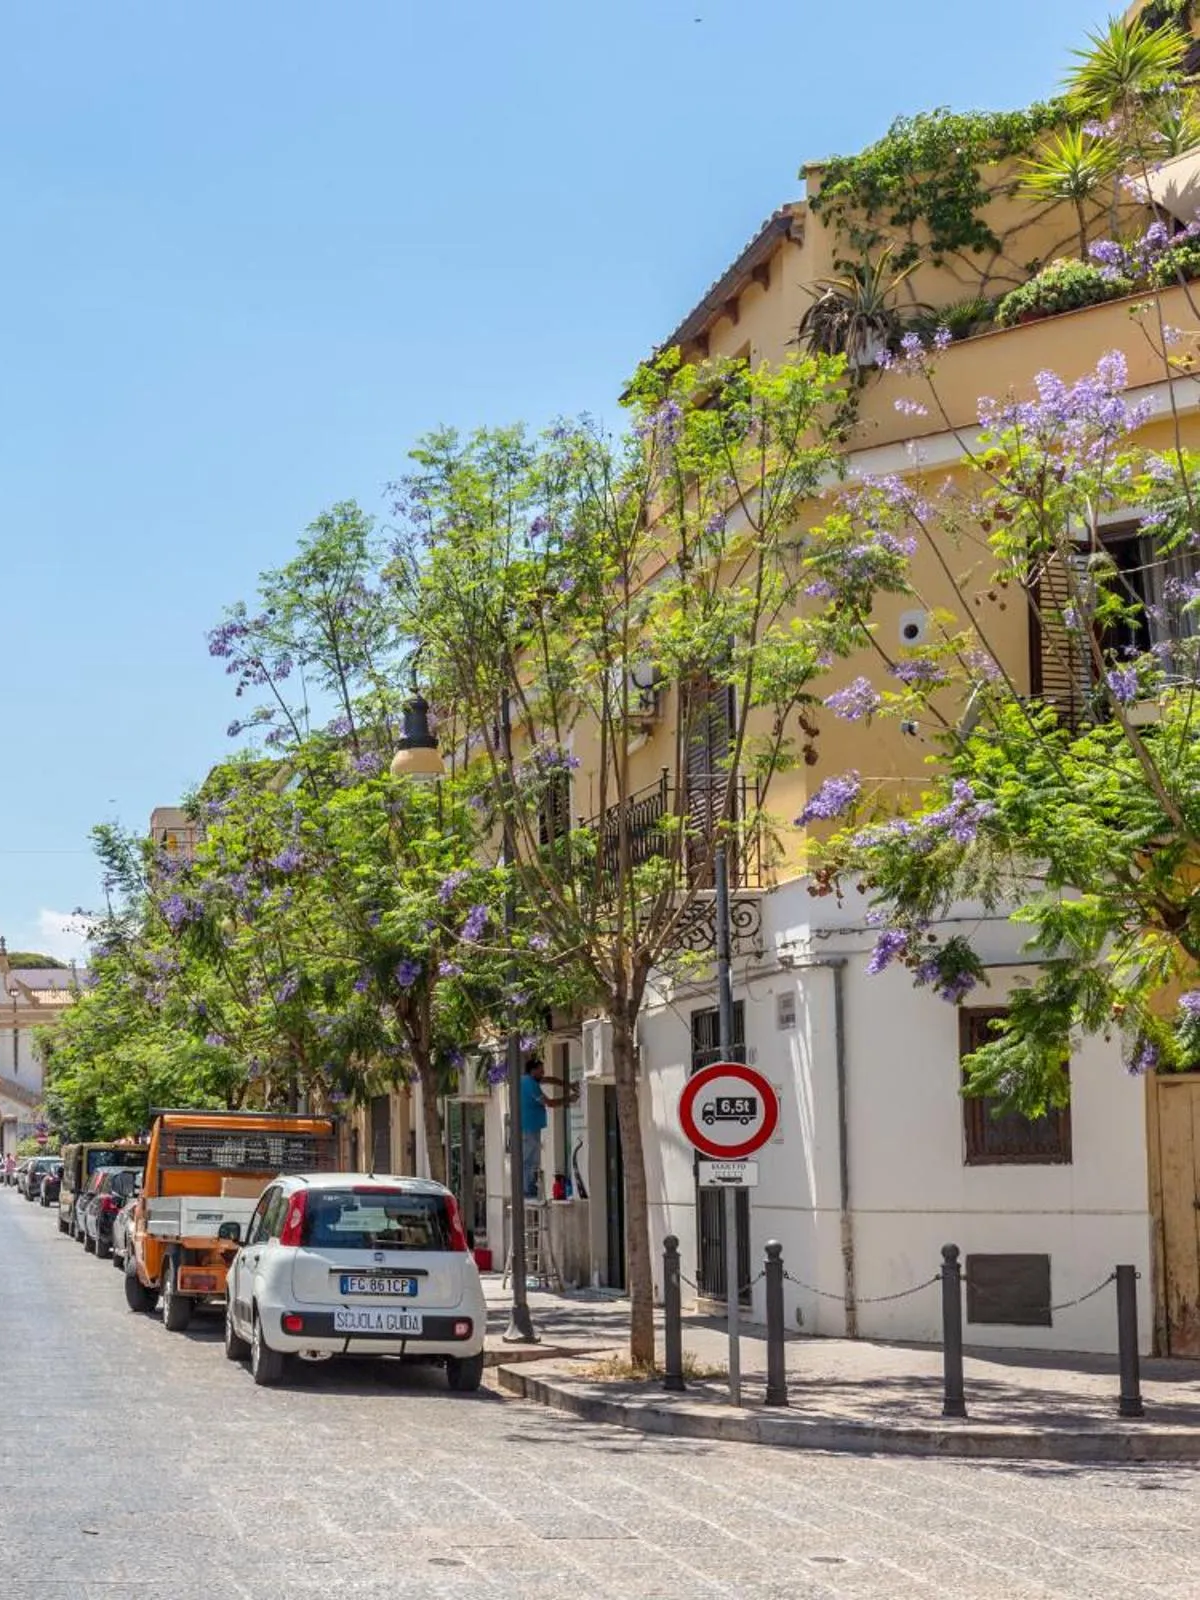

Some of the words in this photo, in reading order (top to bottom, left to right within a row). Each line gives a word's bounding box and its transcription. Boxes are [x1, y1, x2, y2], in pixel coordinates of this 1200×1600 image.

[721, 1100, 750, 1114] 6,5t
[370, 1279, 409, 1292] 861CP
[337, 1312, 383, 1330] SCUOLA
[386, 1314, 420, 1332] GUIDA
